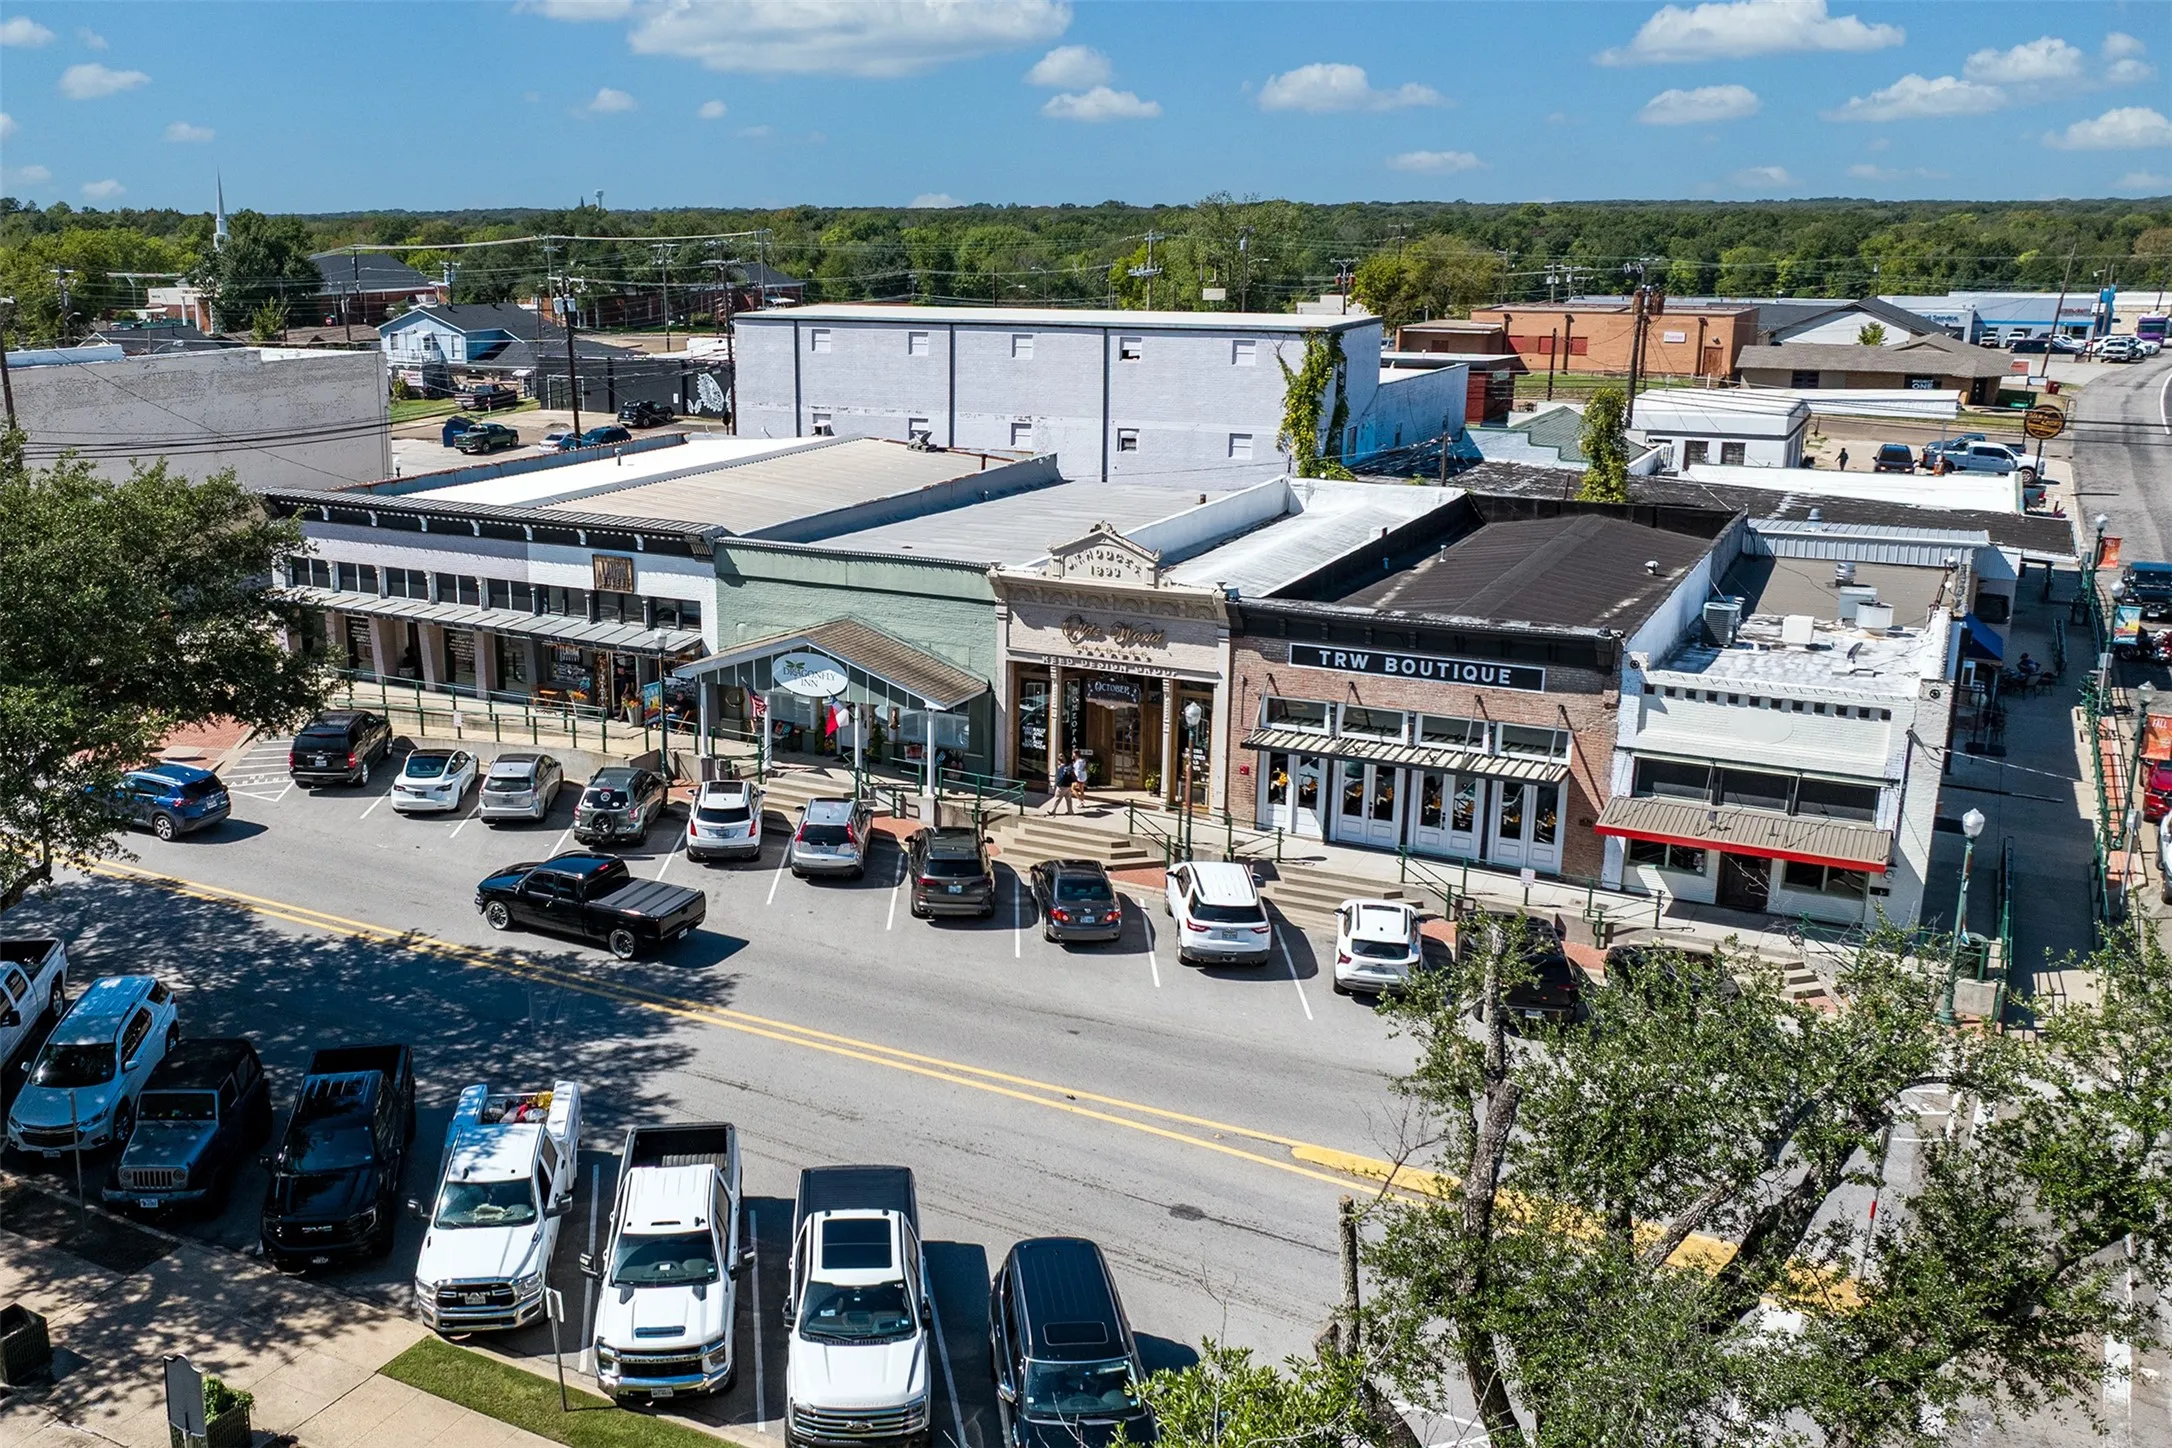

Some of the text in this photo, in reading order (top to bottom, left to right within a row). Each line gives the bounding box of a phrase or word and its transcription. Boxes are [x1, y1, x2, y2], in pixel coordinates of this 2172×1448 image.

[1062, 613, 1165, 645] Olde World
[1072, 645, 1149, 658] TRADERS
[1041, 655, 1074, 667] REED
[1080, 659, 1129, 674] DESIGN
[1318, 649, 1512, 685] TRW BOUTIQUE
[782, 666, 836, 681] DRAGONFLY
[800, 678, 818, 688] INN
[2151, 718, 2168, 729] FALL
